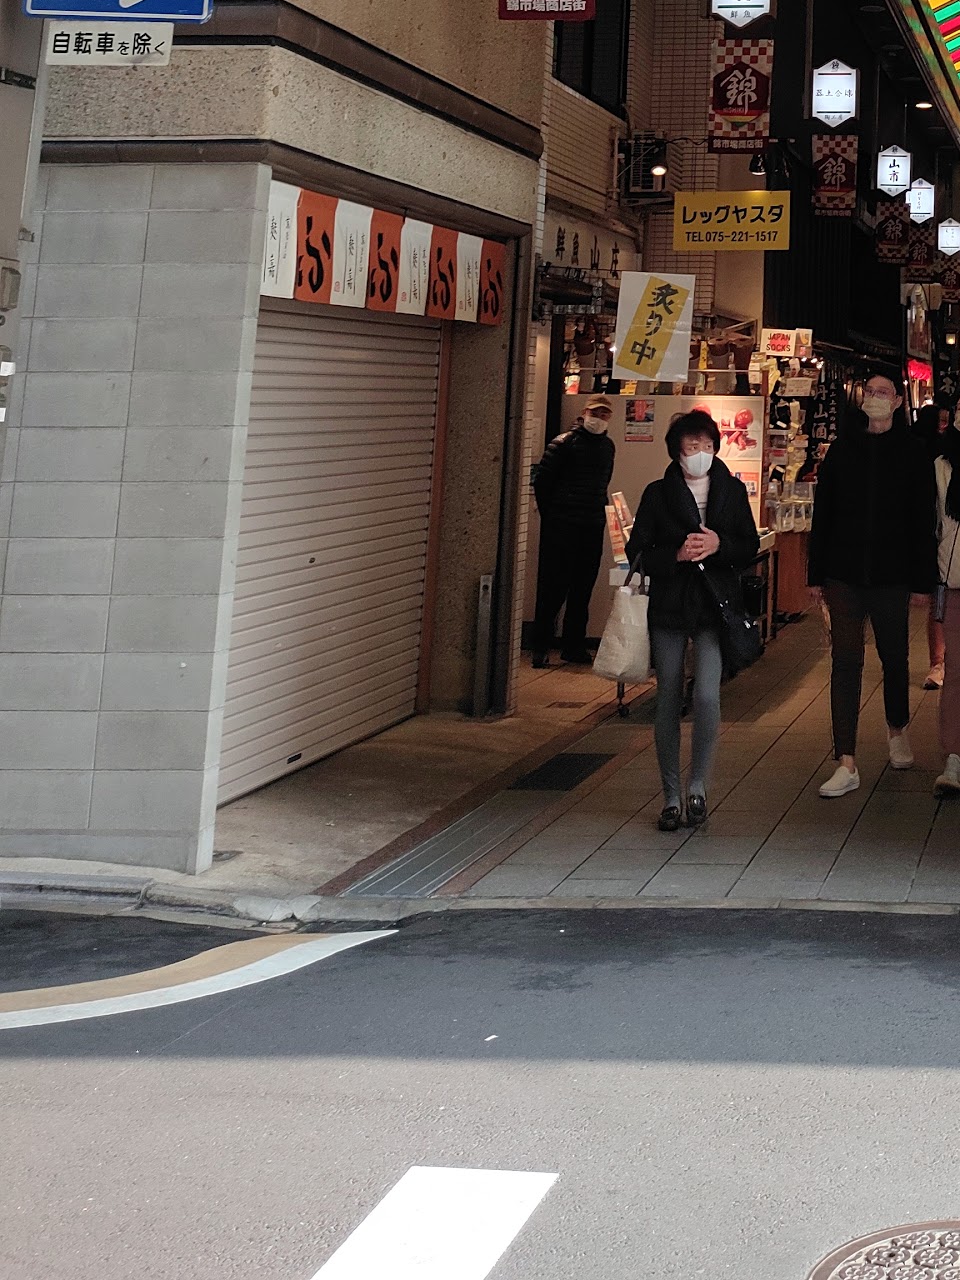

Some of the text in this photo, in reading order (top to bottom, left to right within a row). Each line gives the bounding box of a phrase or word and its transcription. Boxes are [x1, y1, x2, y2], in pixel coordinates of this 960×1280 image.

[52, 31, 166, 56] 自転車を除く
[719, 68, 758, 115] 錦
[818, 156, 847, 192] 錦
[682, 204, 784, 224] レッグヤスダ
[629, 283, 679, 366] 炙り中
[767, 332, 791, 341] JAPAN
[766, 343, 791, 352] SOCKS
